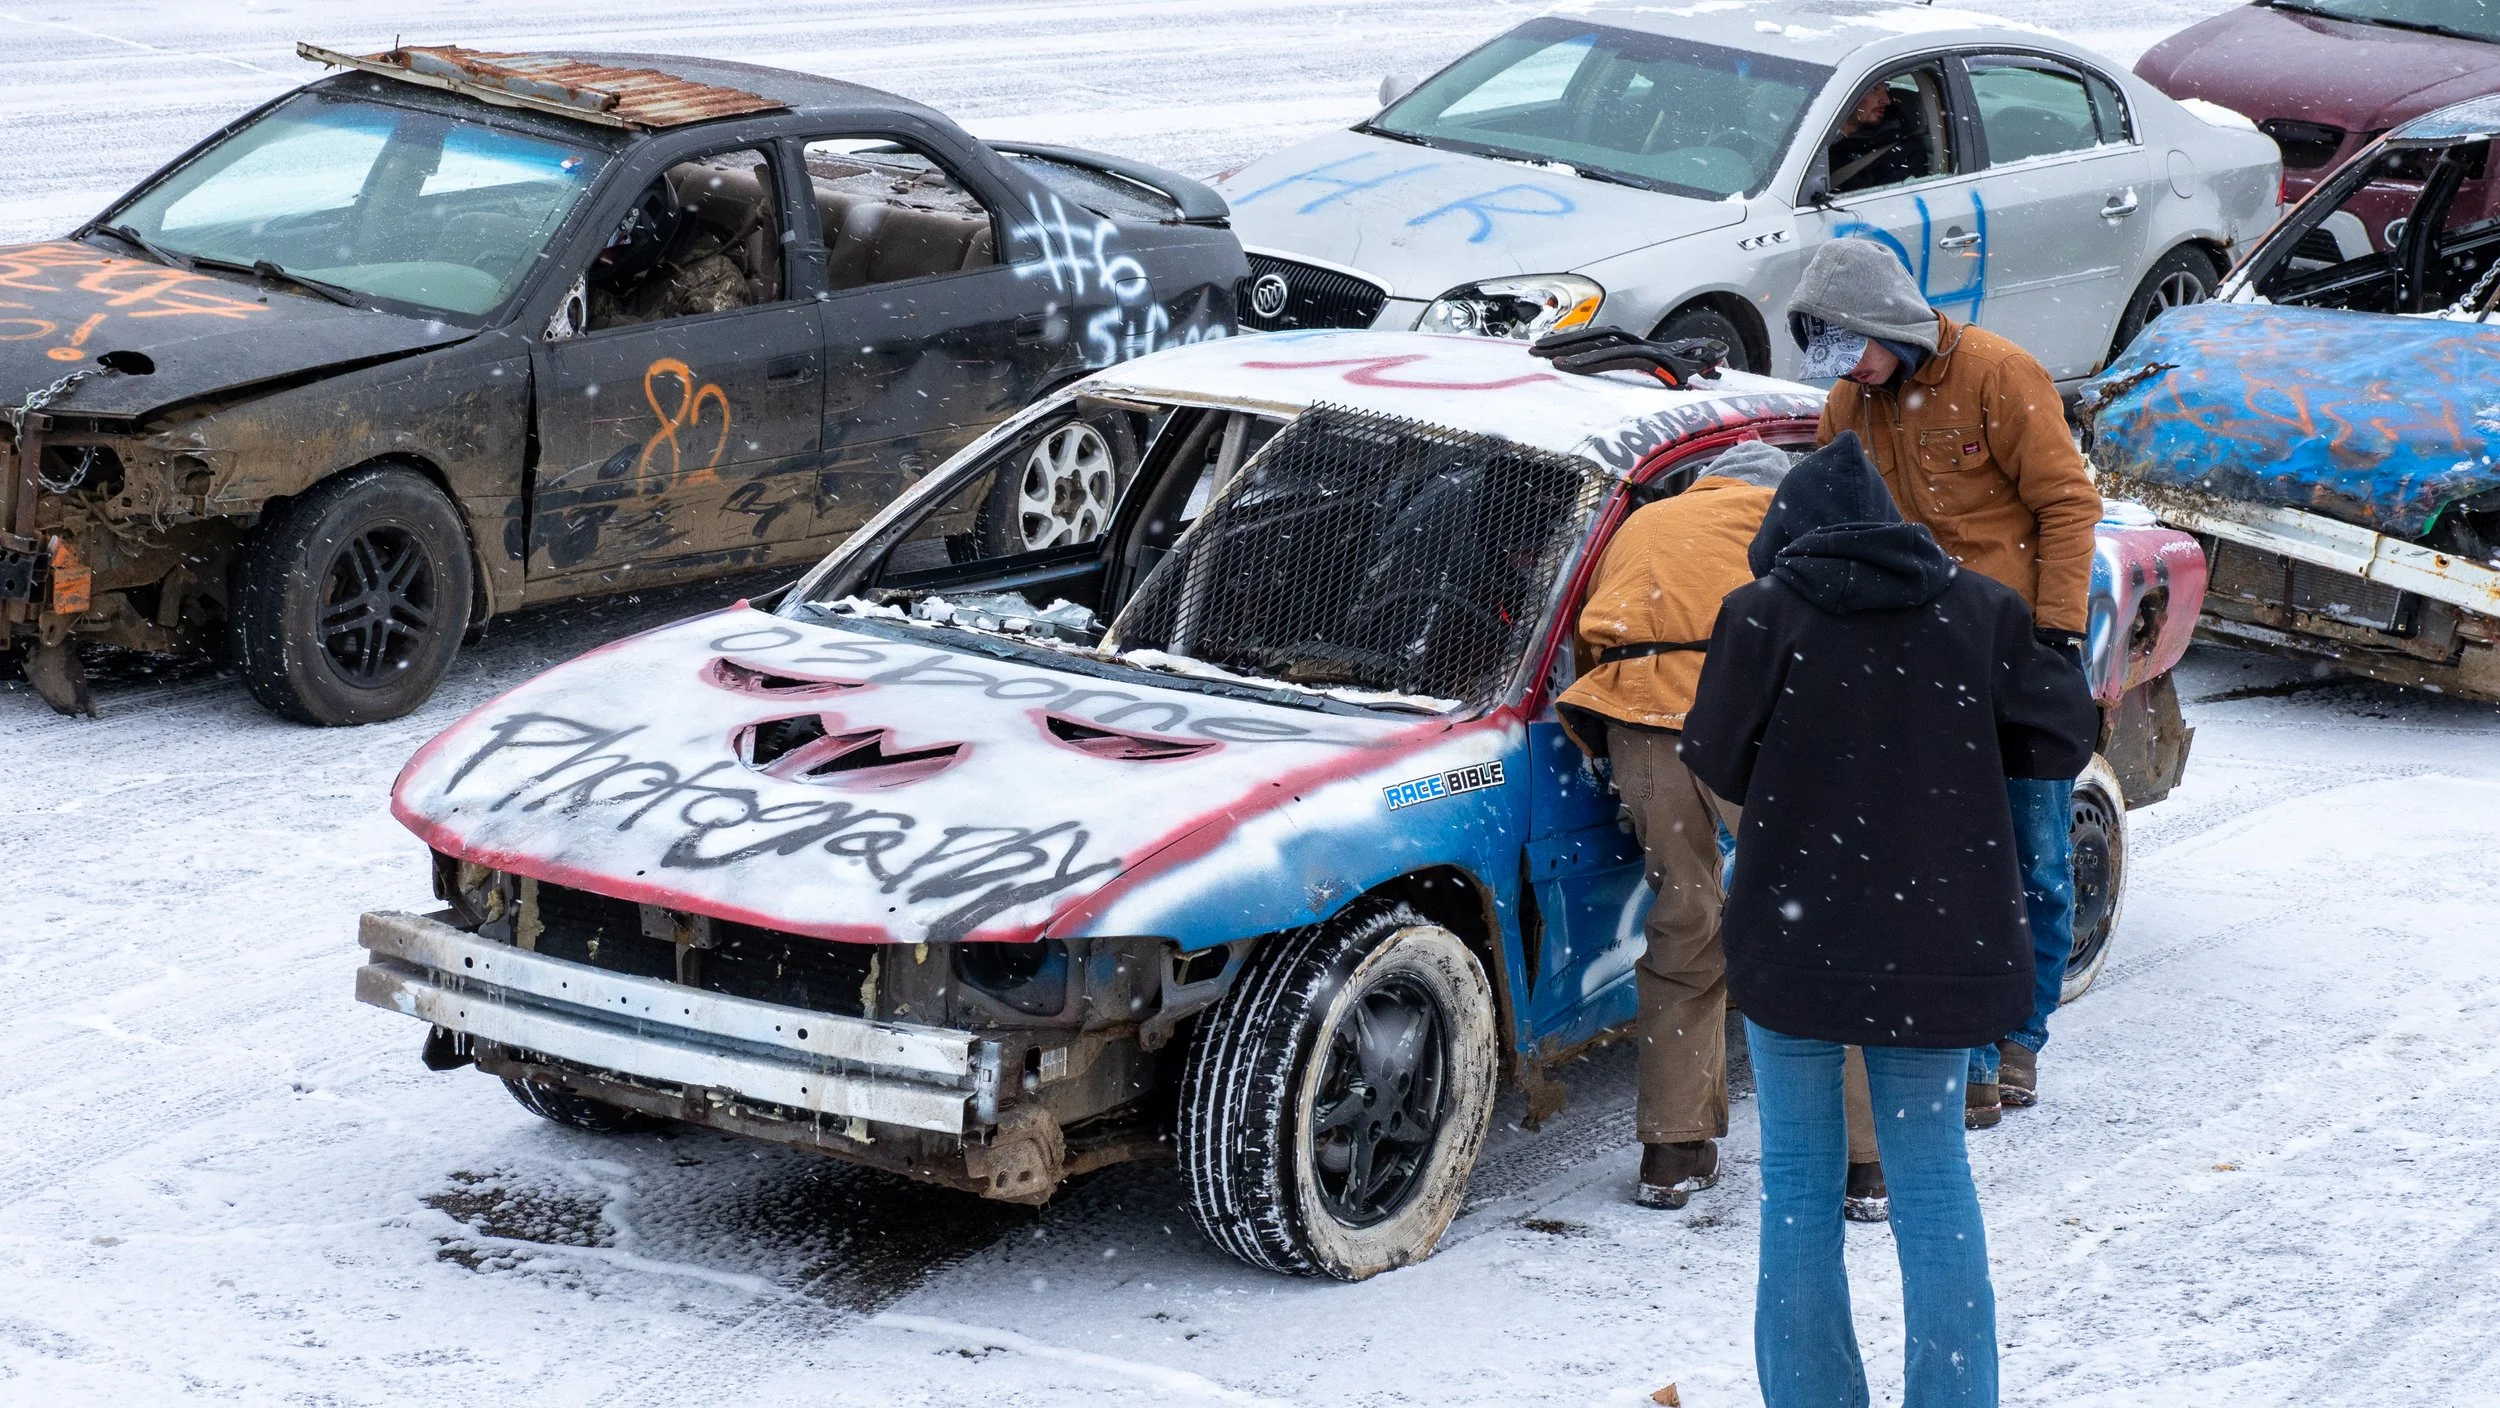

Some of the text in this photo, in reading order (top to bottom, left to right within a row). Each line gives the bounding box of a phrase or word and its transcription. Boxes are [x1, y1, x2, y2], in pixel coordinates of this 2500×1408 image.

[637, 357, 730, 498] 82
[1384, 762, 1504, 809] RACE BIBLE
